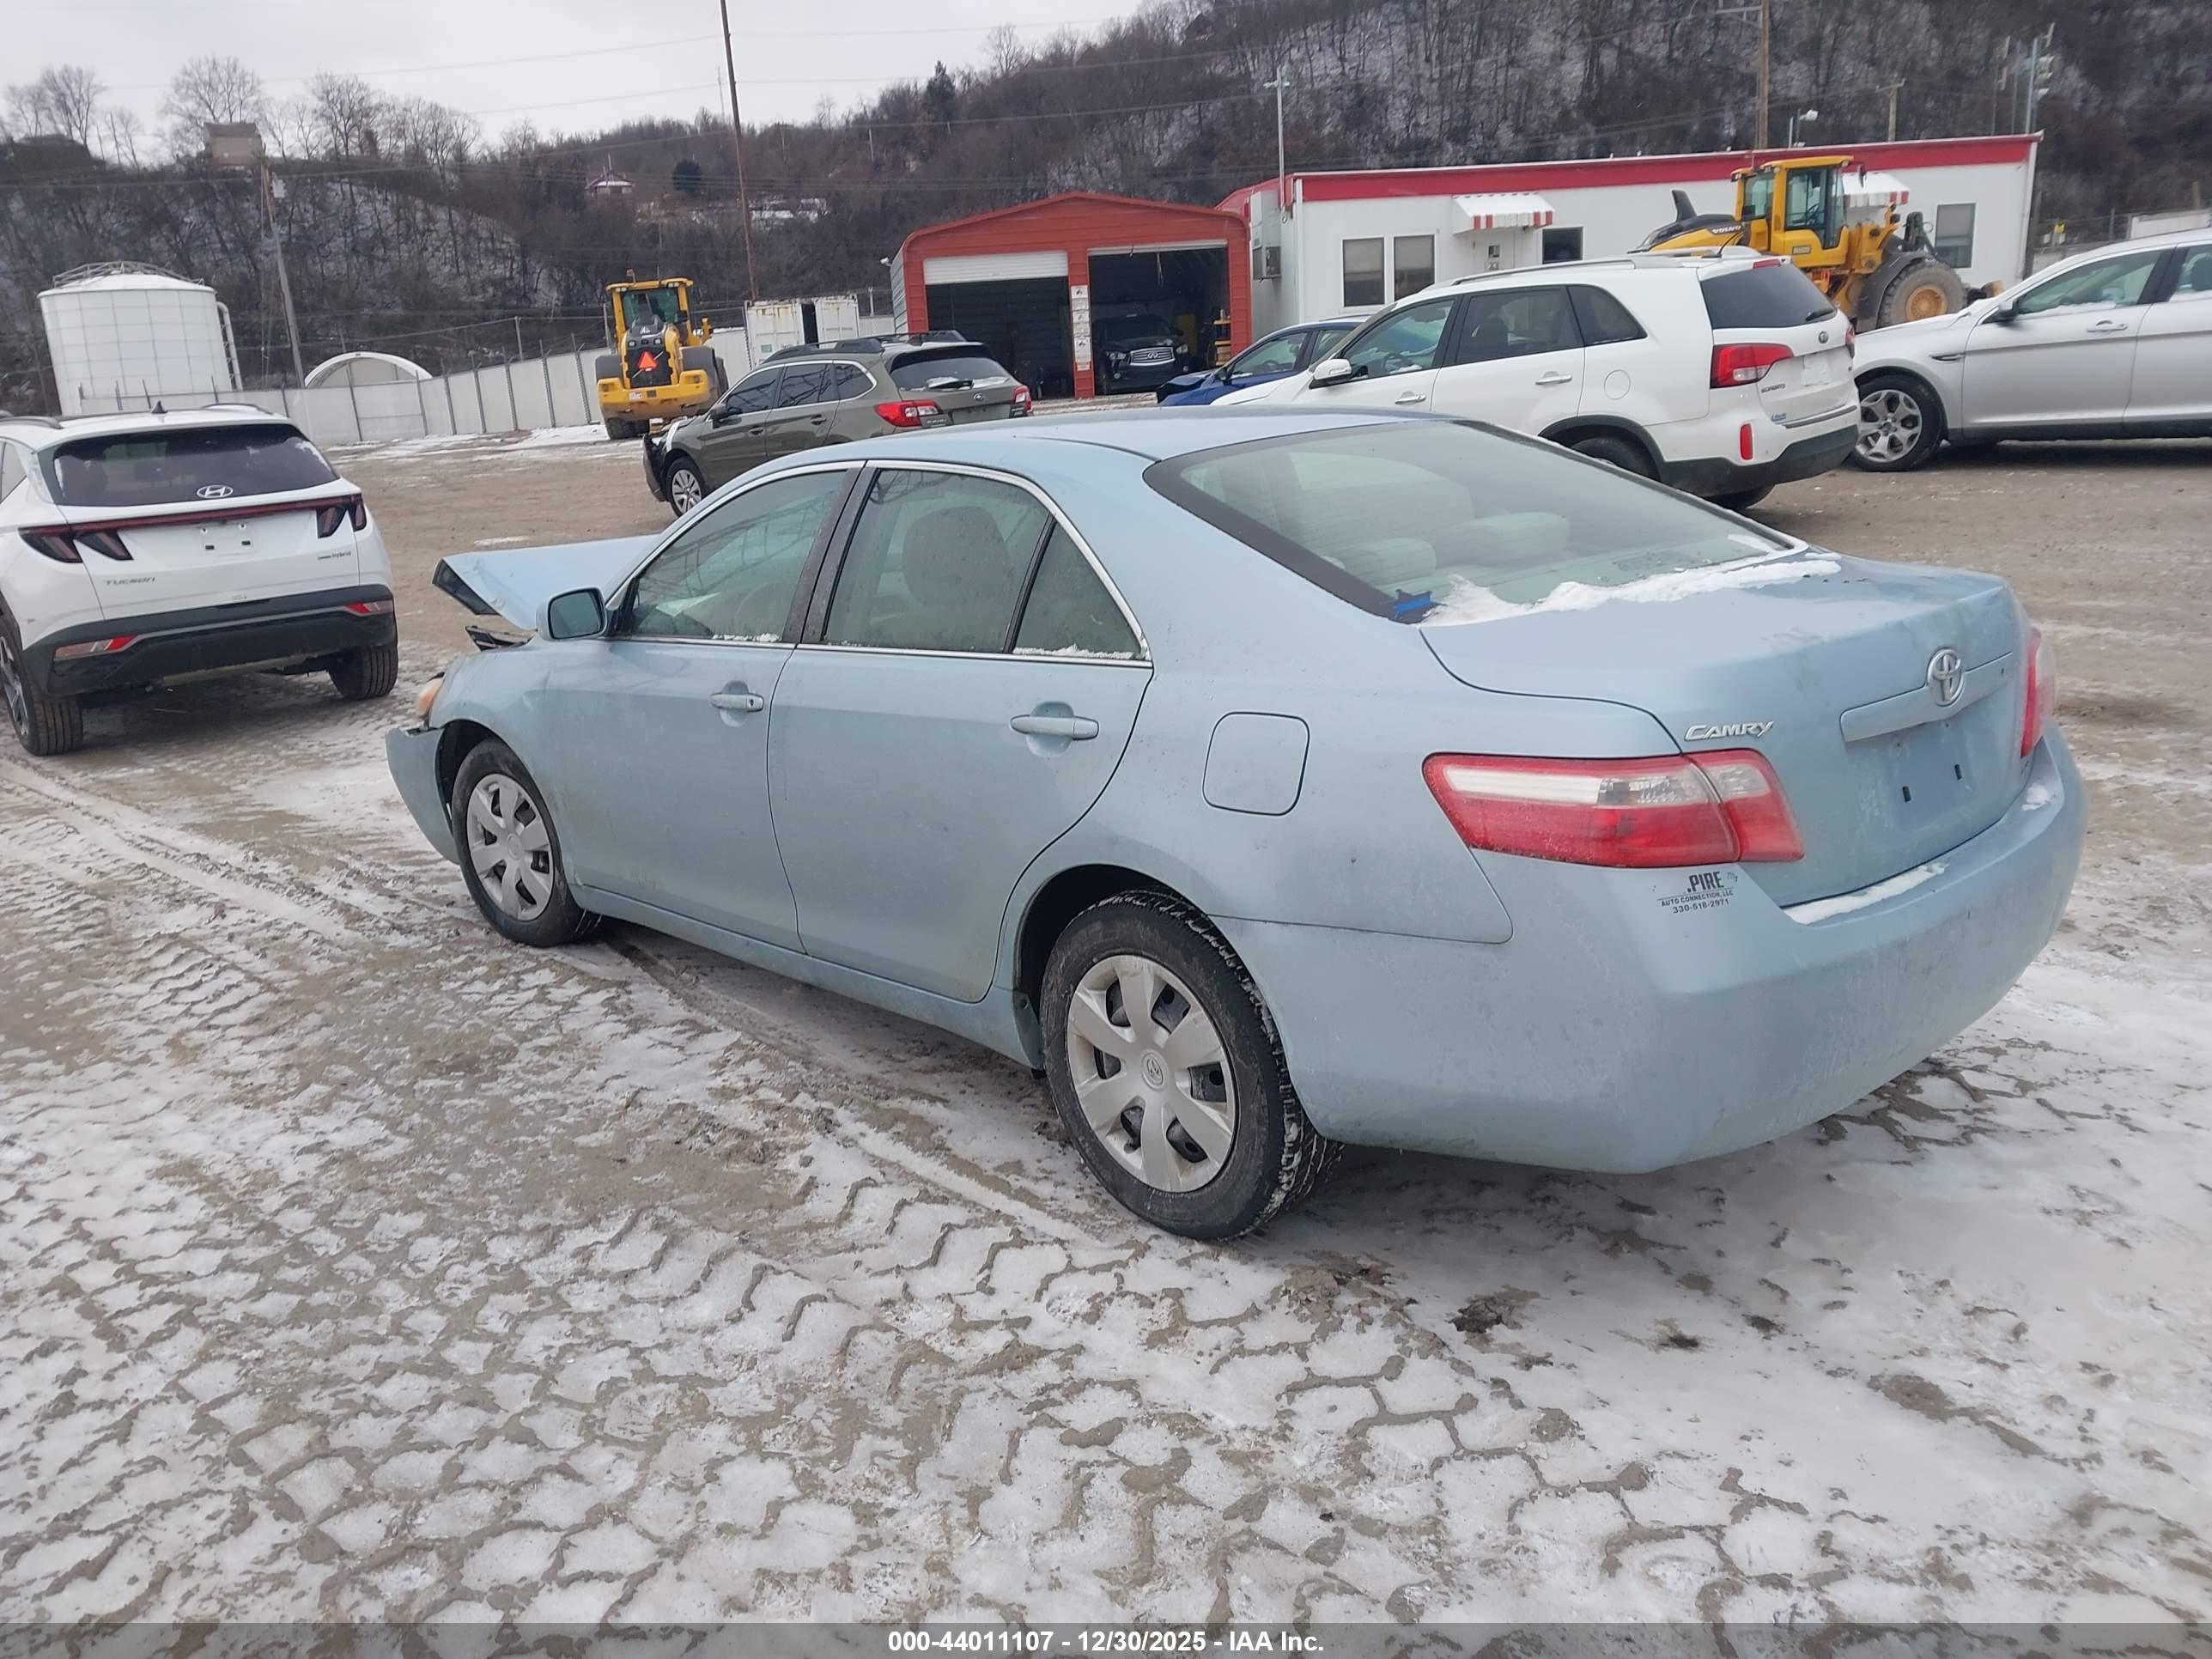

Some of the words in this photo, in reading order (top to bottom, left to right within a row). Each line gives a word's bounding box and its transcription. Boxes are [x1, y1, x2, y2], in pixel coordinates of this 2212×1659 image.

[1711, 225, 1741, 234] VOLVO
[104, 576, 155, 586] TUCSON
[1684, 720, 1774, 741] CAMRY
[1661, 898, 1680, 907] AUTO
